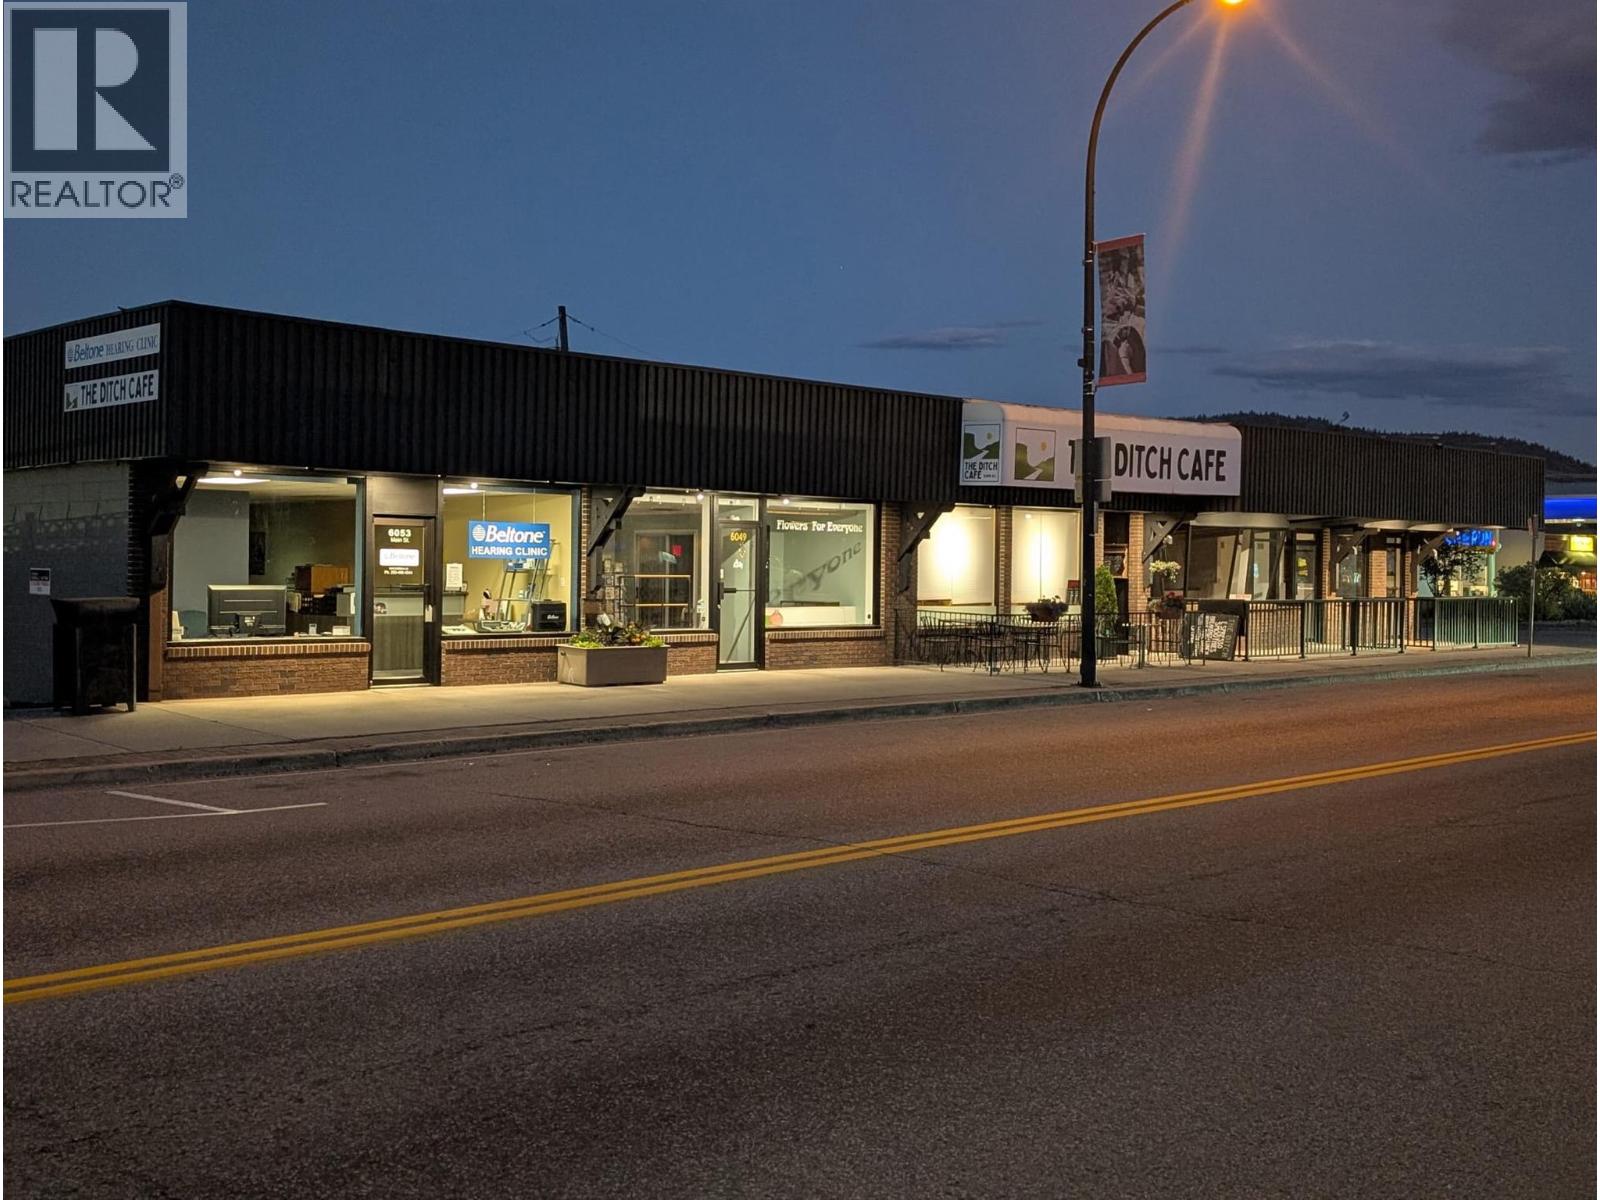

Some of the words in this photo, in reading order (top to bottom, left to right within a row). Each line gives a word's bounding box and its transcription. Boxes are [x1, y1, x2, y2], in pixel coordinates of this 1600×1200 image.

[73, 344, 104, 362] Beltone
[106, 342, 134, 356] HEARING
[136, 334, 158, 350] CLINIC
[81, 383, 98, 406] THE
[100, 379, 126, 403] DITCH
[128, 374, 154, 399] CAFE
[965, 461, 977, 470] THE
[979, 461, 998, 471] DITCH
[1114, 443, 1172, 480] DITCH
[1177, 448, 1227, 482] CAFE
[965, 470, 982, 480] CAFE
[388, 528, 412, 537] 6053
[776, 519, 809, 532] Flowers
[811, 520, 826, 532] For
[827, 521, 864, 535] Everyone
[485, 525, 545, 543] Beltone
[730, 531, 748, 542] 6049
[471, 546, 513, 556] HEARING
[515, 547, 548, 556] CLINIC
